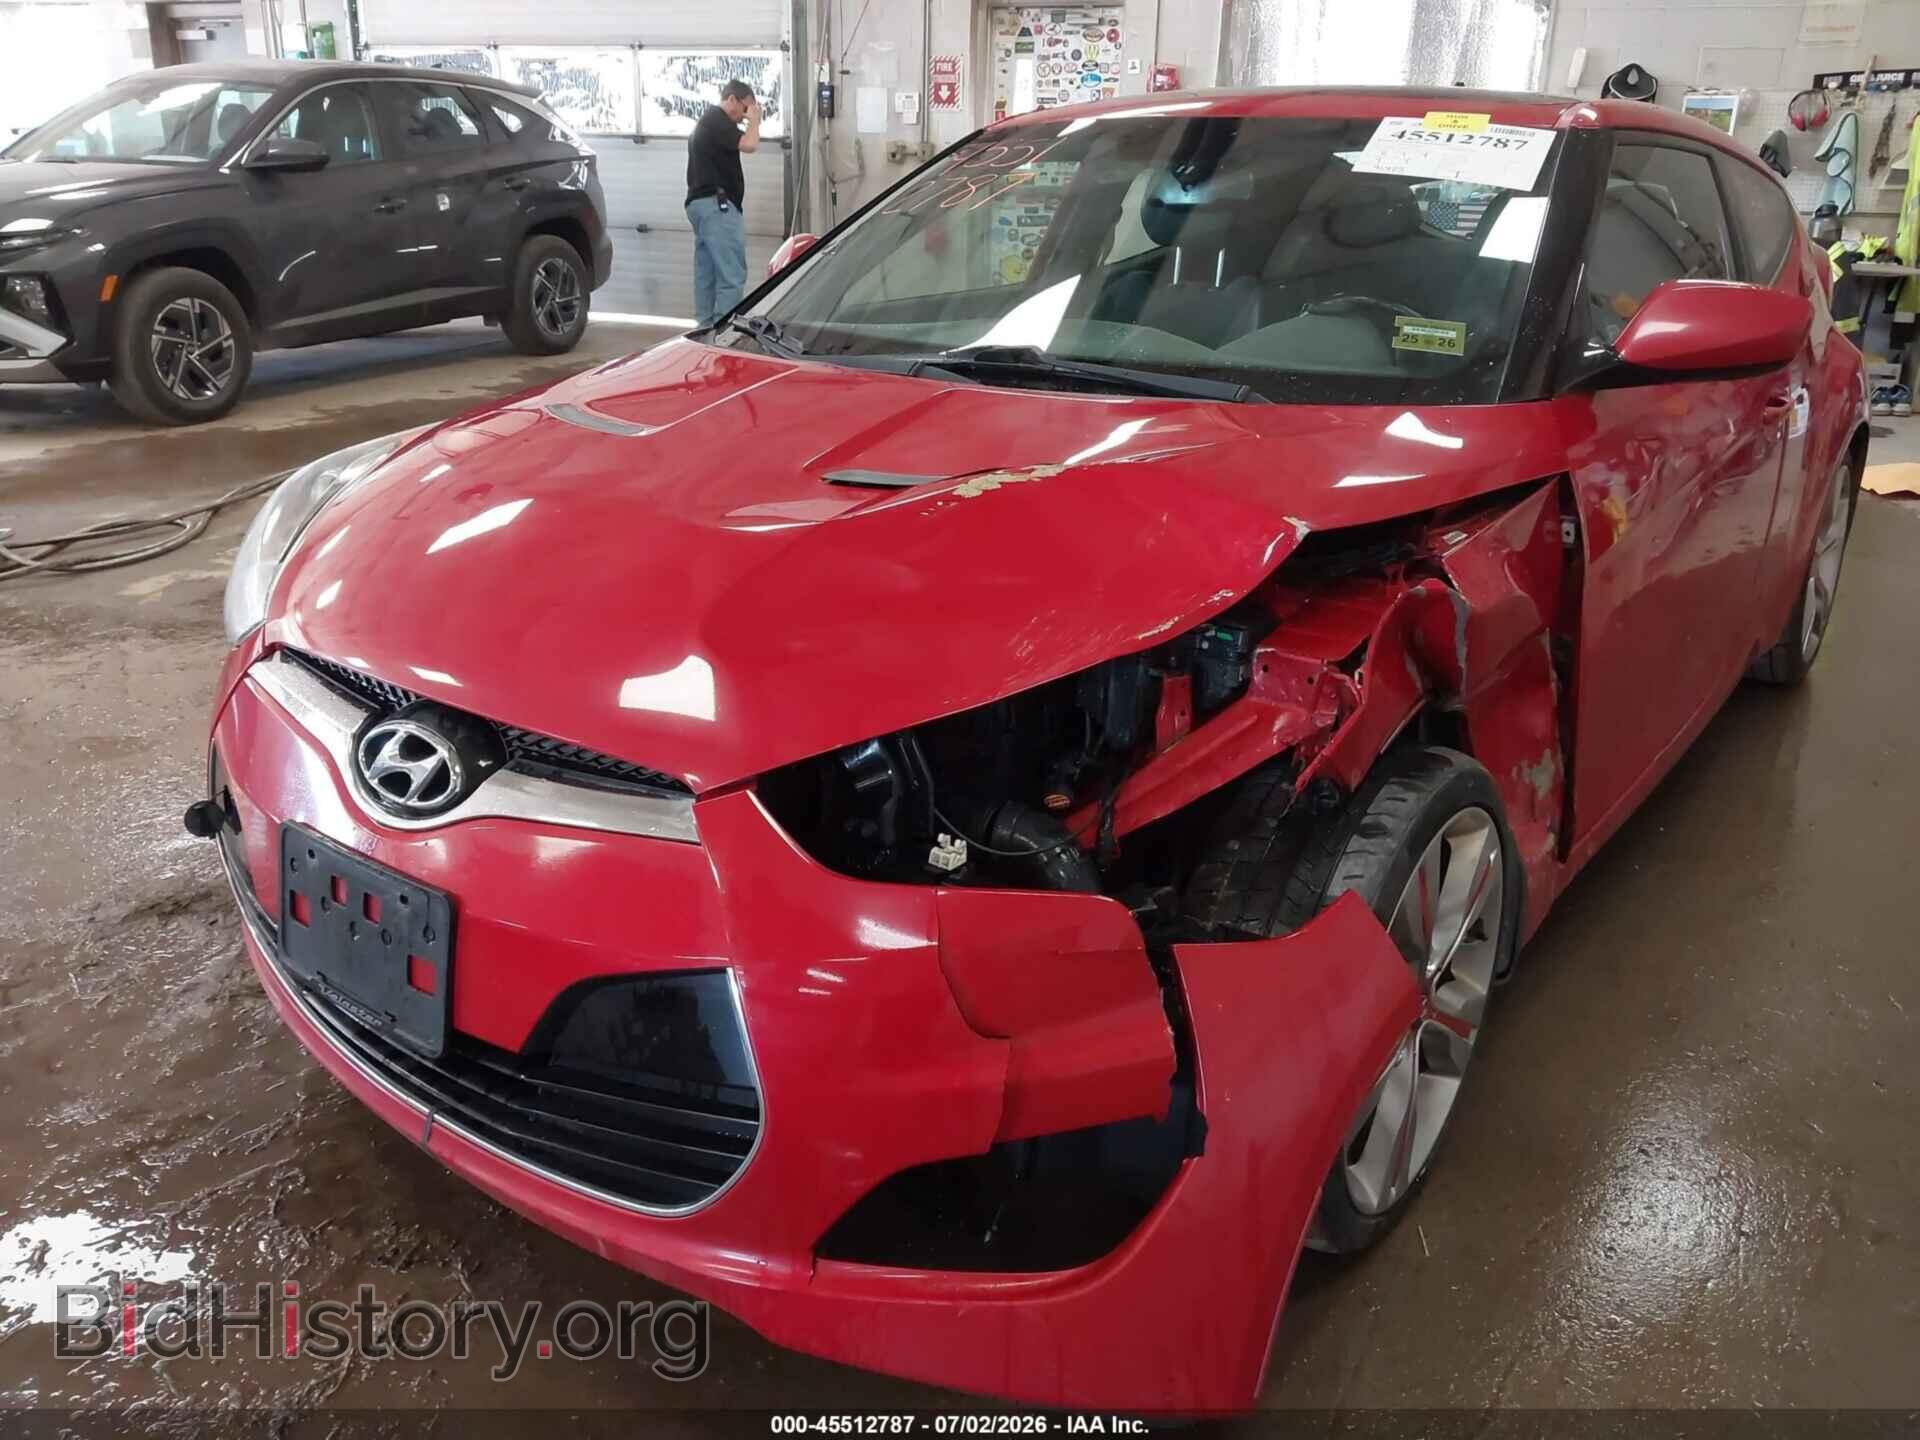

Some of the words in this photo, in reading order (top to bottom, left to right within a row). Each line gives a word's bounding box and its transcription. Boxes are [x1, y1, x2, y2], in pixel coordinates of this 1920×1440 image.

[1391, 129, 1528, 150] 45512787
[1401, 334, 1418, 344] 25
[1438, 338, 1456, 349] 26
